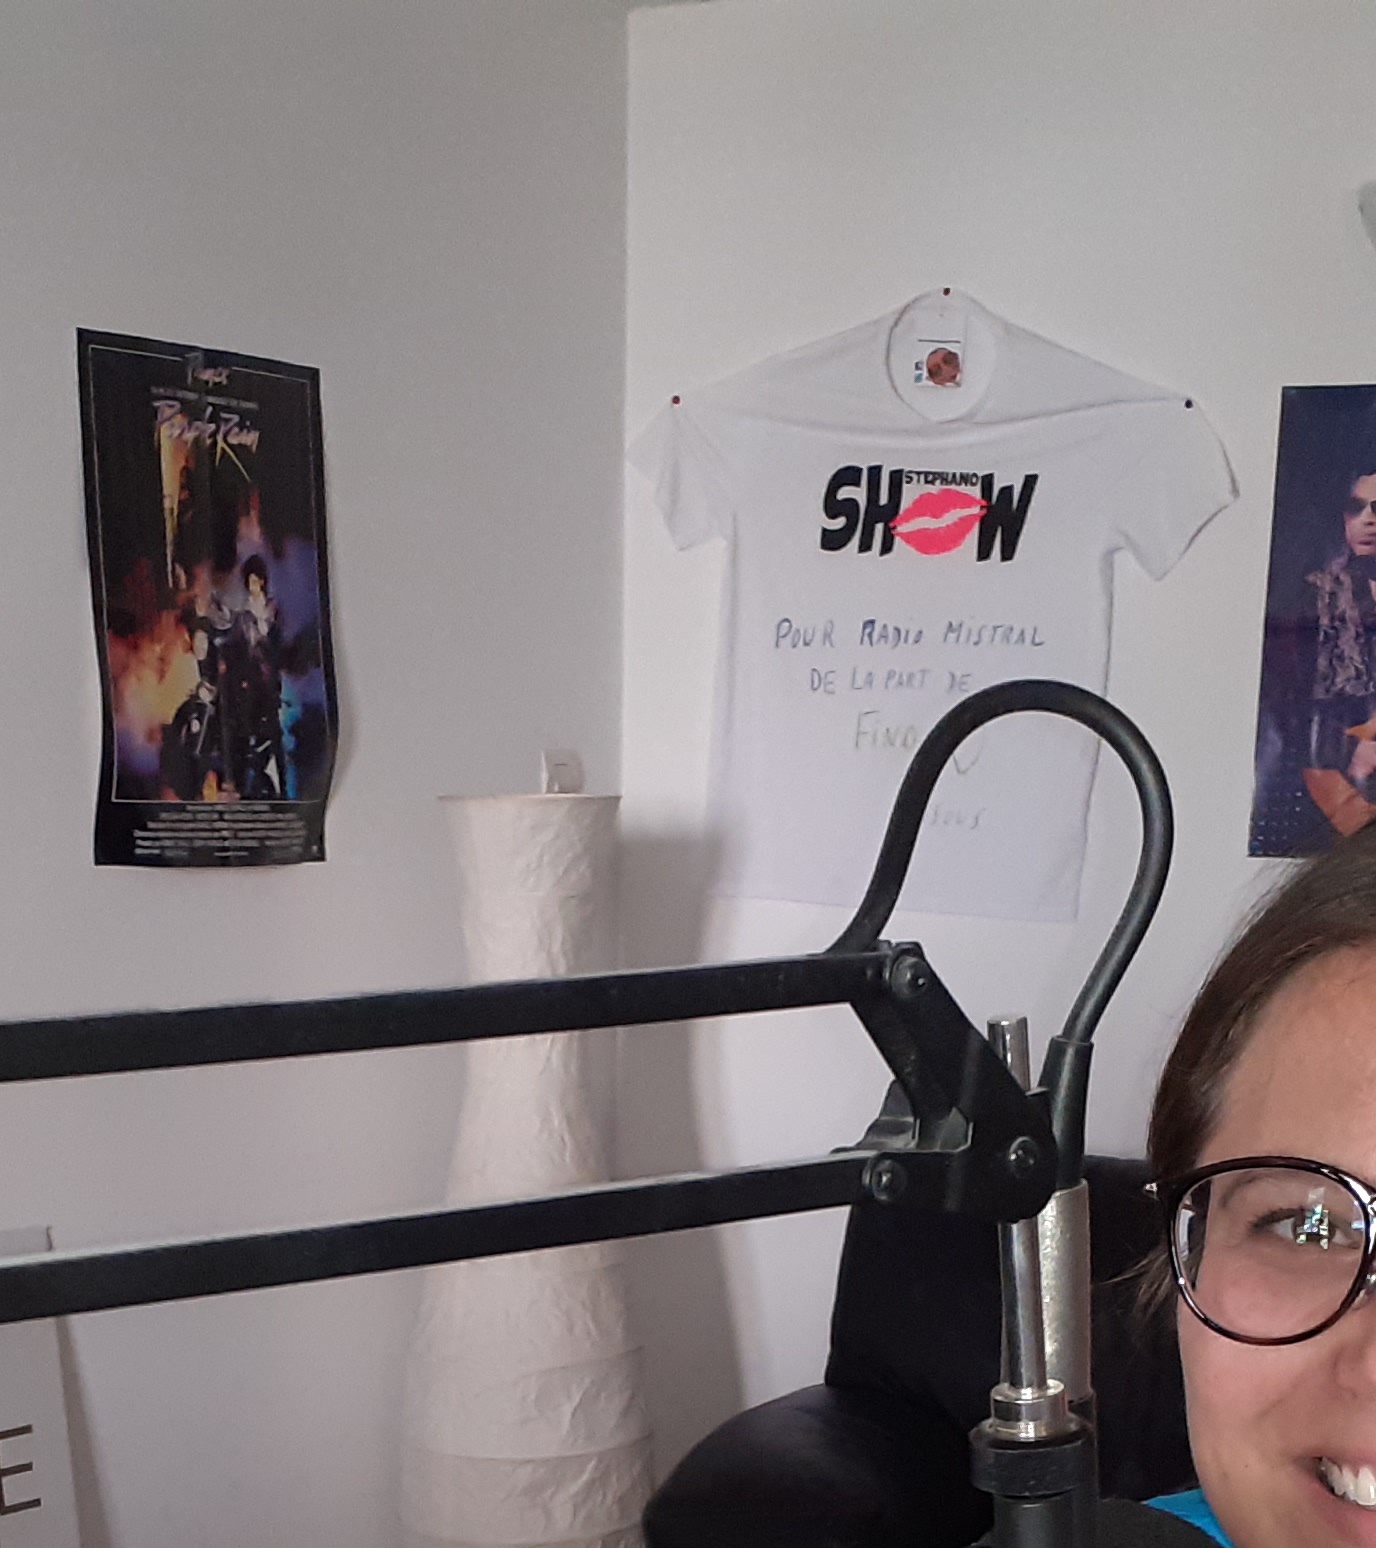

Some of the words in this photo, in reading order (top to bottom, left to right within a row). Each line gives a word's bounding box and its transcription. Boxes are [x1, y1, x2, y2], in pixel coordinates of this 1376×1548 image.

[905, 470, 980, 488] STEPHANO
[809, 667, 836, 694] DE
[850, 667, 874, 691] LA
[884, 668, 929, 691] PART
